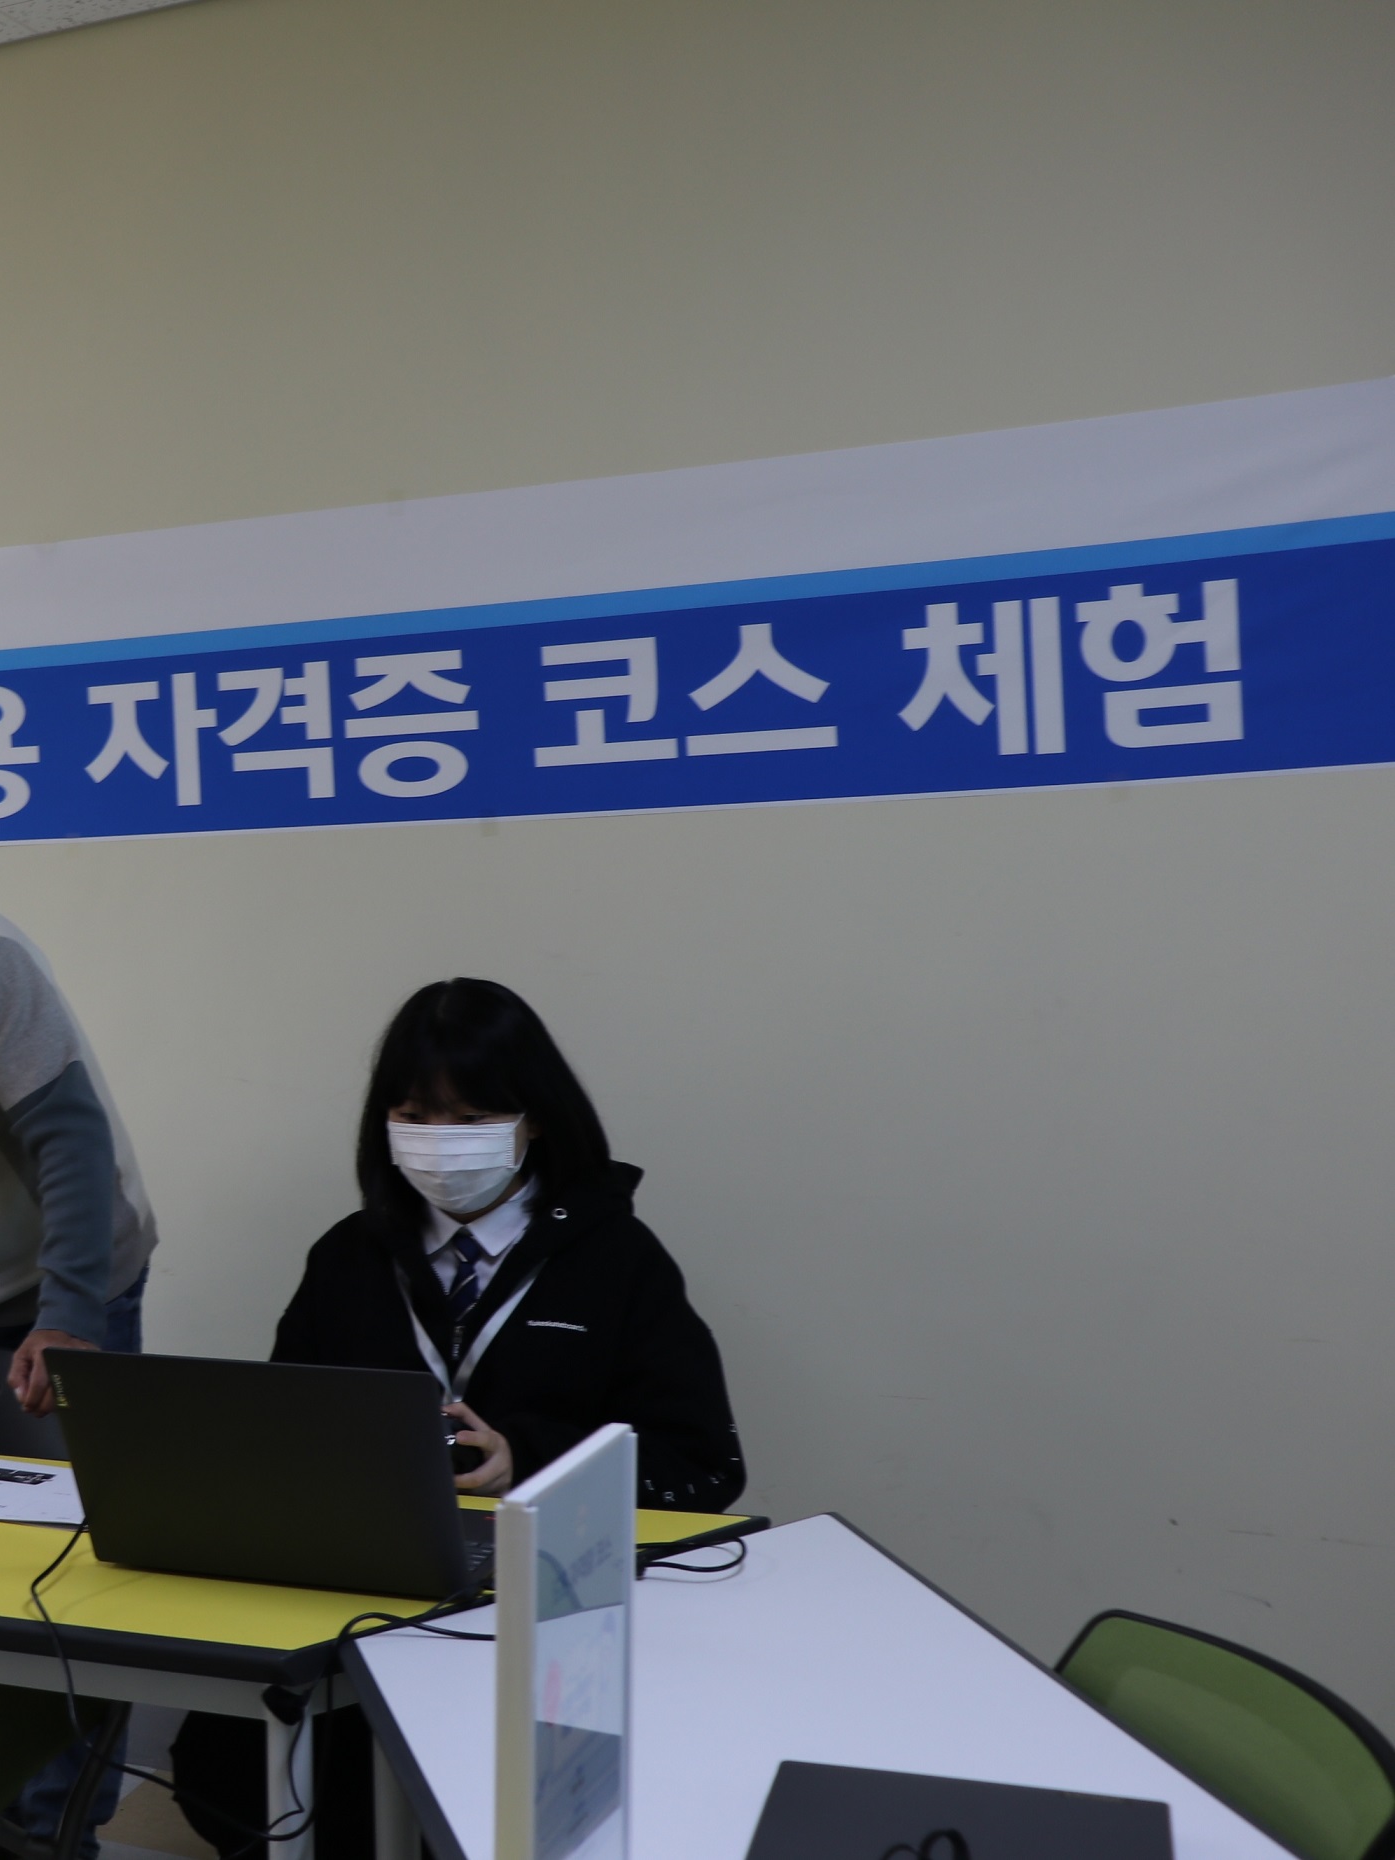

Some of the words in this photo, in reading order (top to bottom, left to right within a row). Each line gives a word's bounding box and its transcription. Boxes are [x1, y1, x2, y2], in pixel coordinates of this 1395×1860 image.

[85, 649, 480, 807] 자격증
[534, 622, 839, 768] 코스
[897, 577, 1245, 756] 체험
